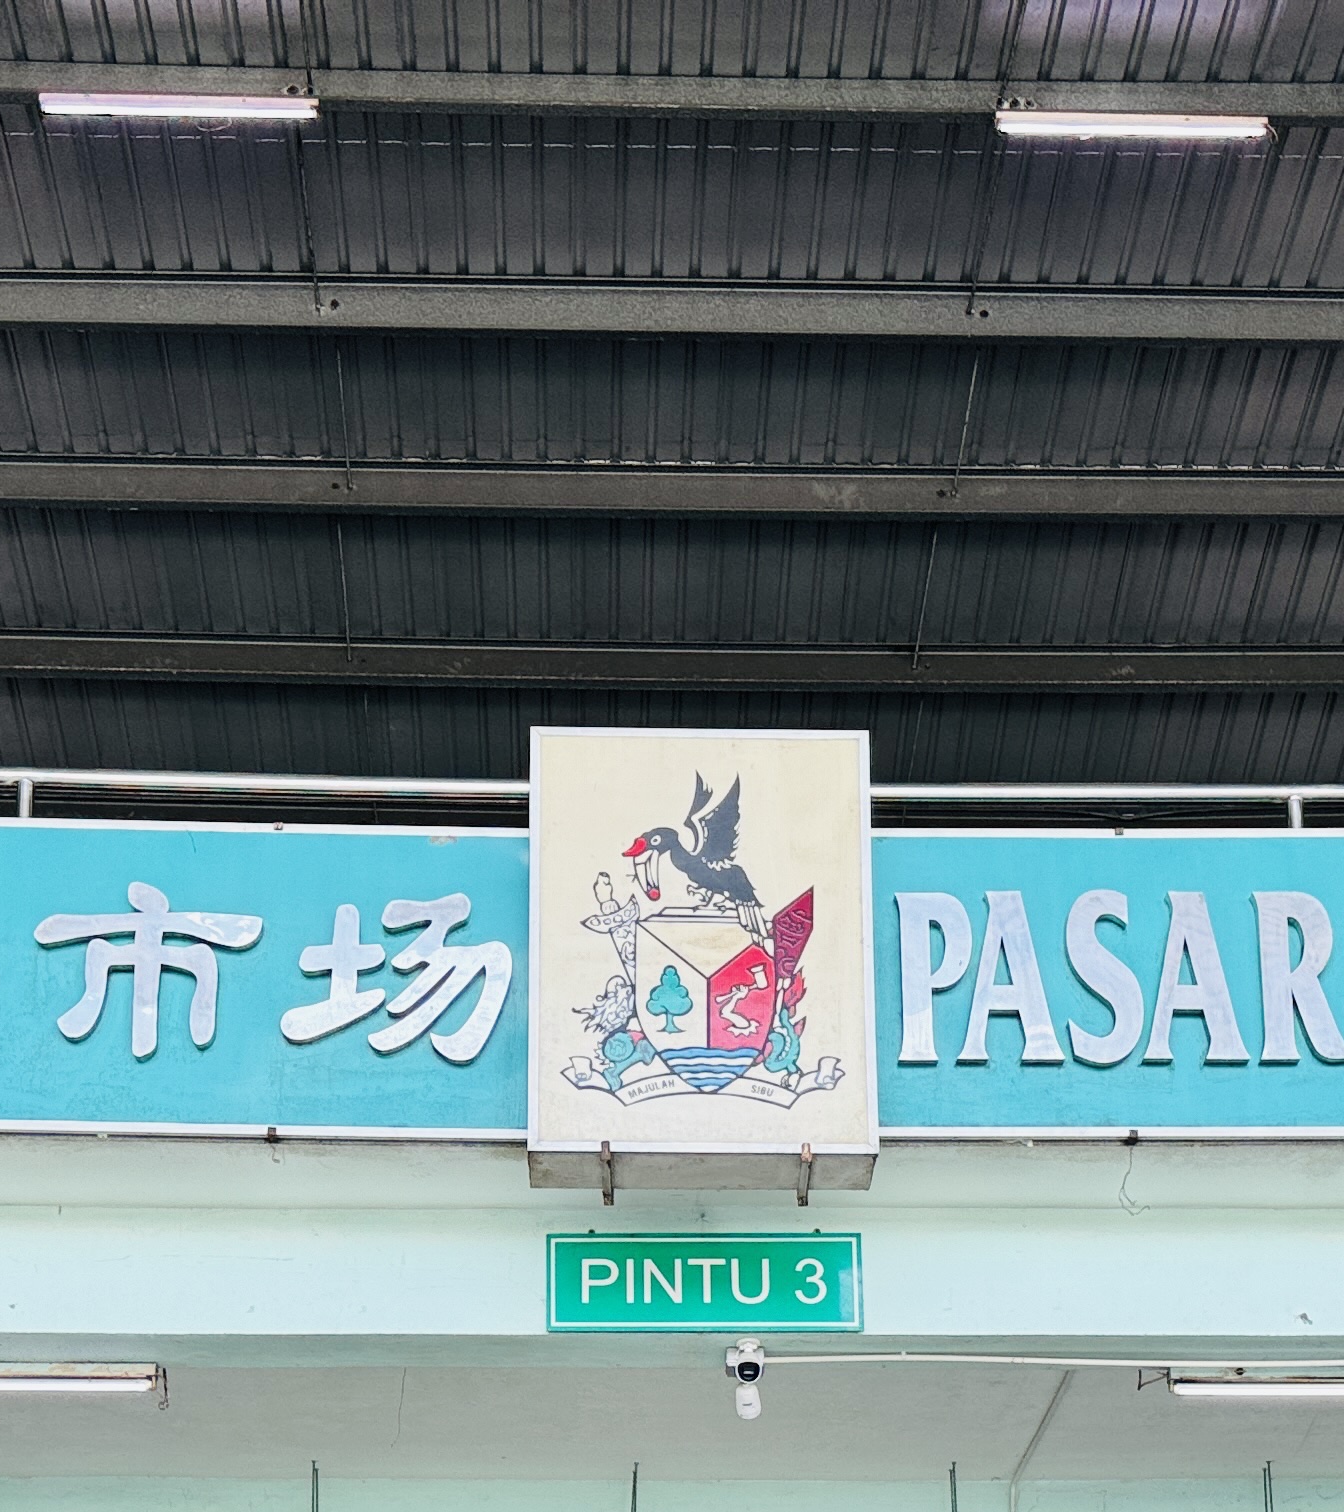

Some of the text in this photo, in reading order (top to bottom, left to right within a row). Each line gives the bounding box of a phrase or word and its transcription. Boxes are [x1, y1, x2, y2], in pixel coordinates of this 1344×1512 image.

[627, 1079, 774, 1099] MAJULAH SIBU
[581, 1258, 828, 1304] PINTU 3
